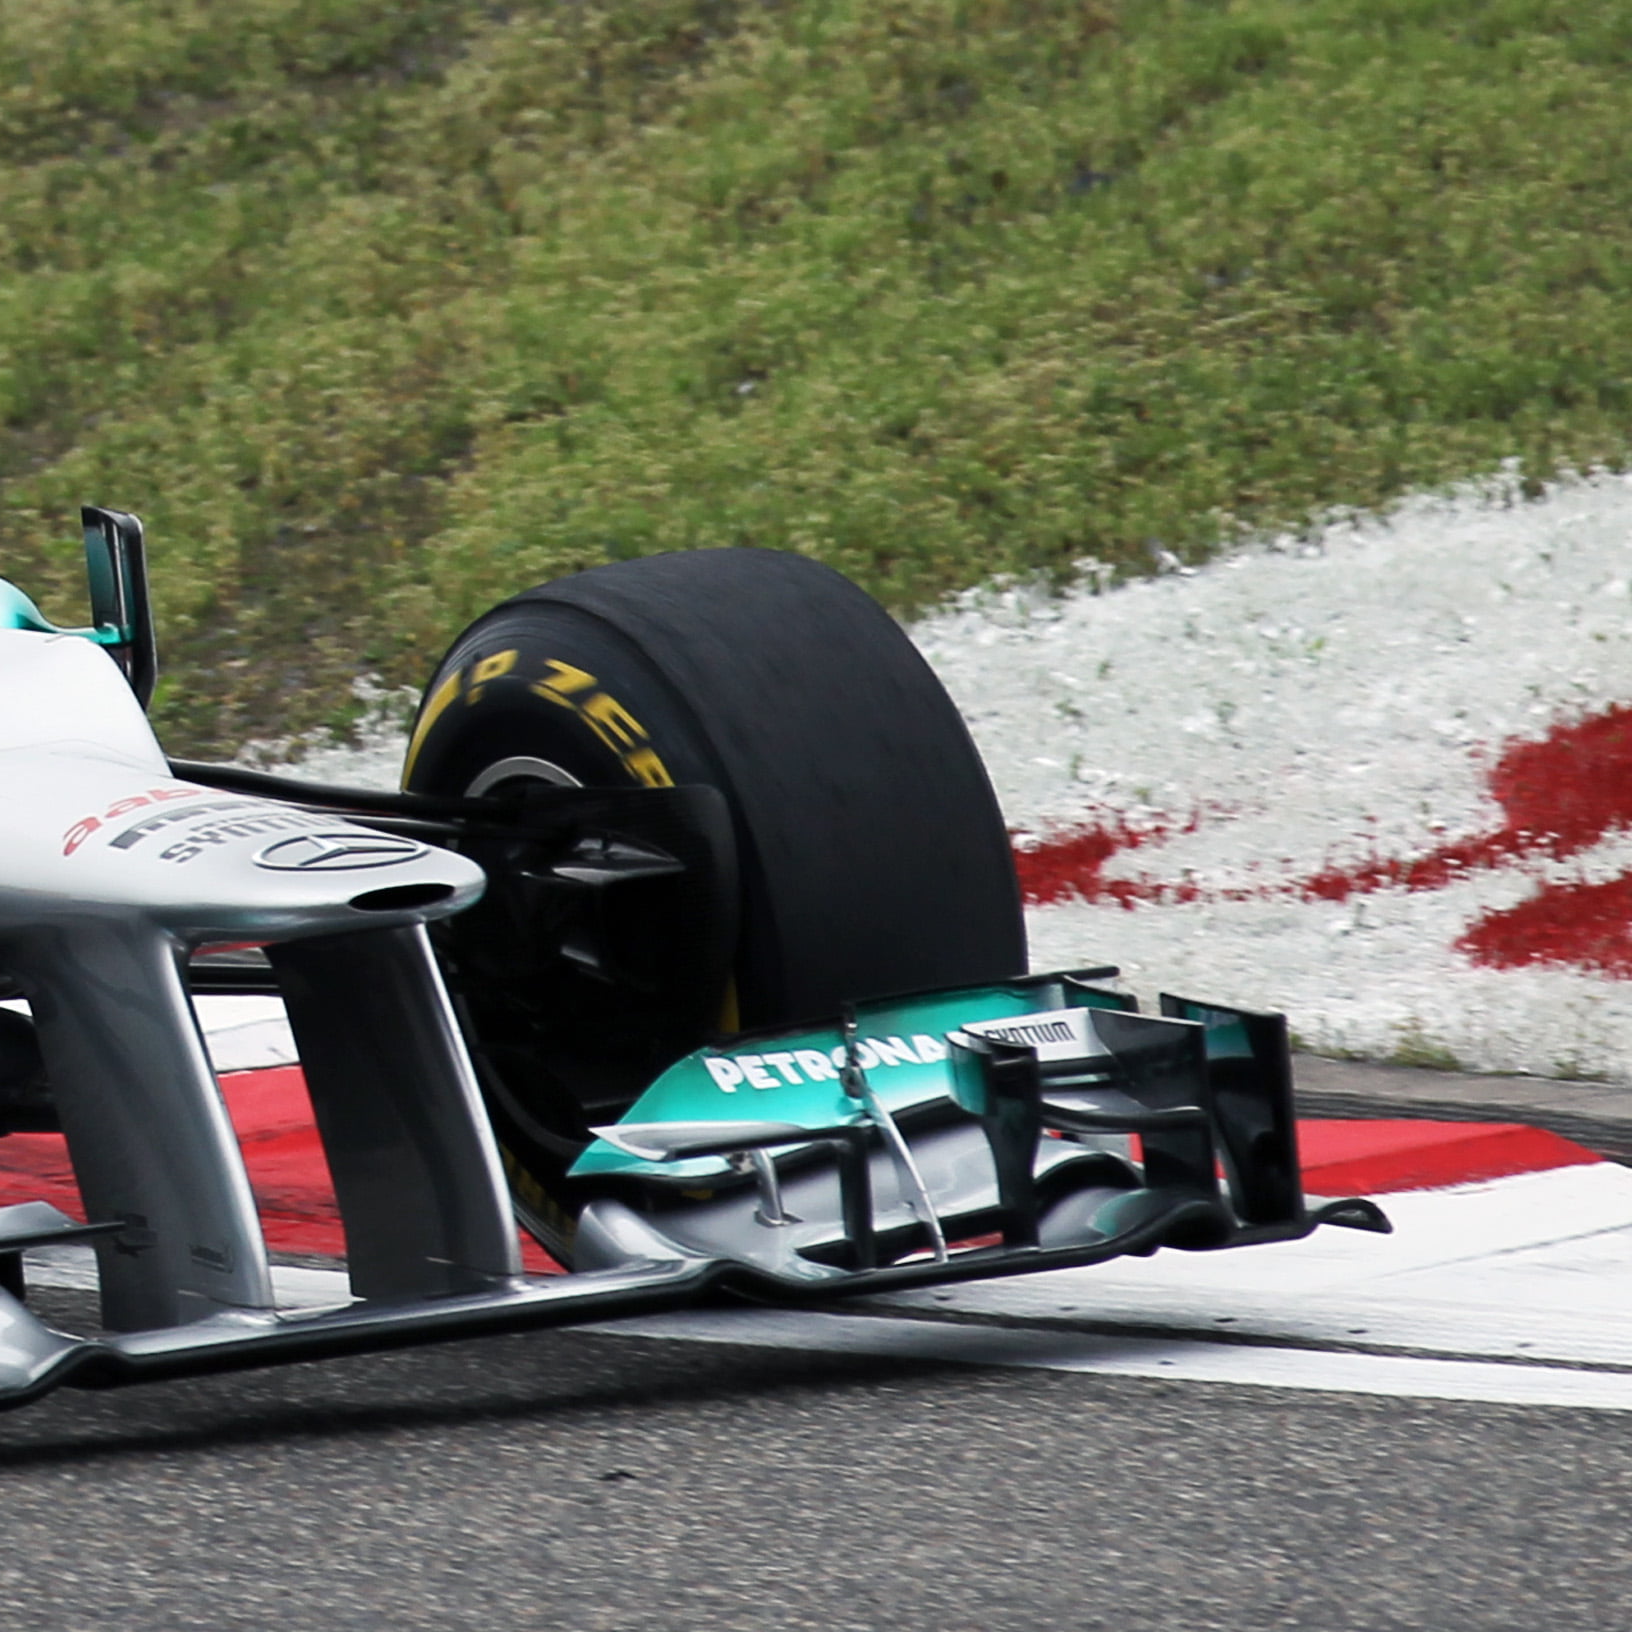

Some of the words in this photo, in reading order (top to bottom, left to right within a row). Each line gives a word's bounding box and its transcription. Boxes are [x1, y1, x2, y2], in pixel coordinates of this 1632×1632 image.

[529, 658, 676, 788] ZER
[63, 787, 237, 856] aab
[703, 1034, 950, 1094] PETRONA
